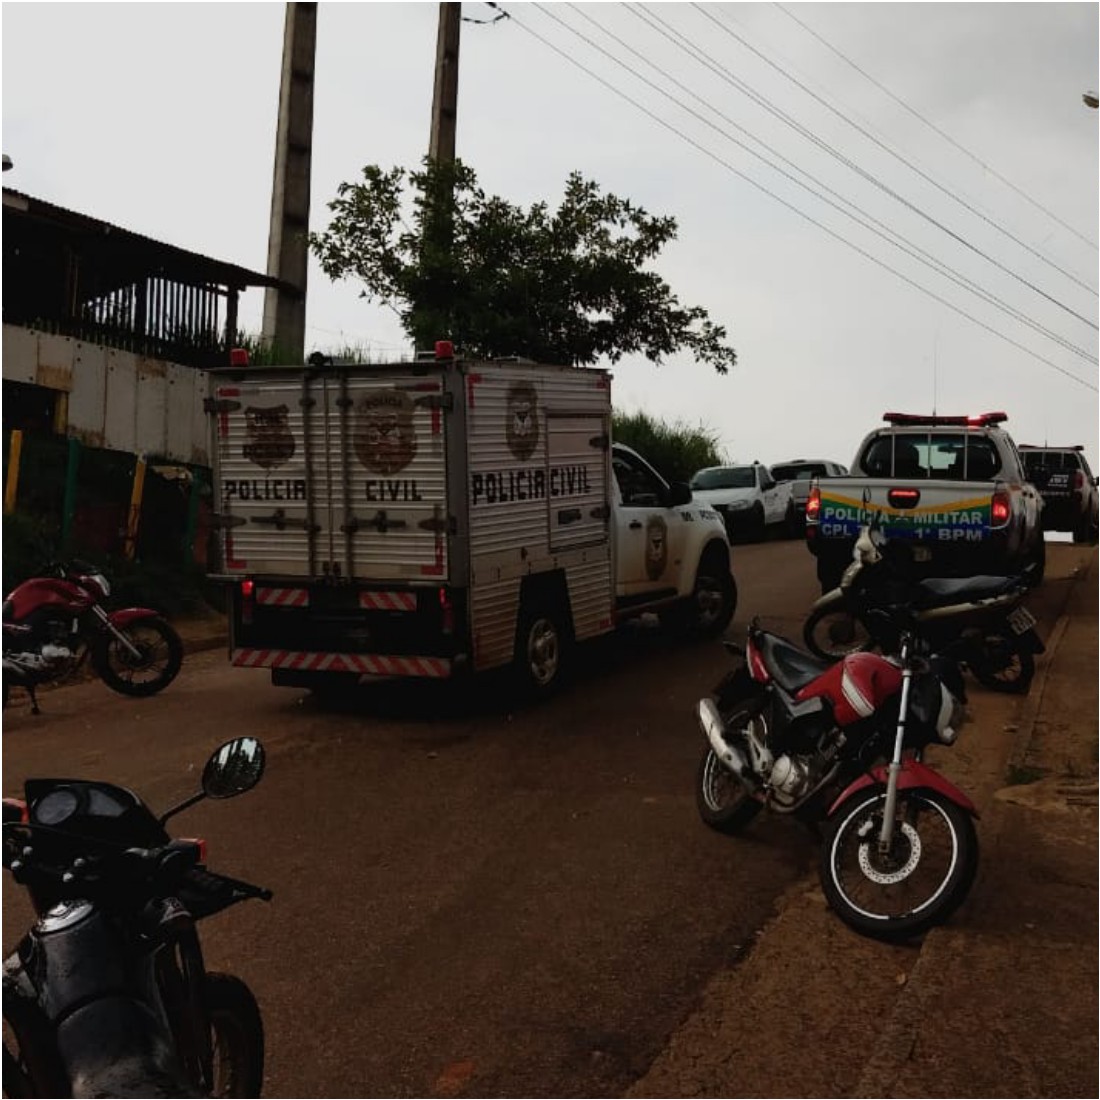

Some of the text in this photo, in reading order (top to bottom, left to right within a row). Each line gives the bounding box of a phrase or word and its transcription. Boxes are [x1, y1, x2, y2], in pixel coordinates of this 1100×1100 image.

[365, 480, 422, 502] CIVIL
[472, 464, 591, 505] POLICIA CIVIL
[914, 511, 983, 525] MILITAR
[821, 524, 852, 537] CPL
[938, 529, 983, 542] BPM
